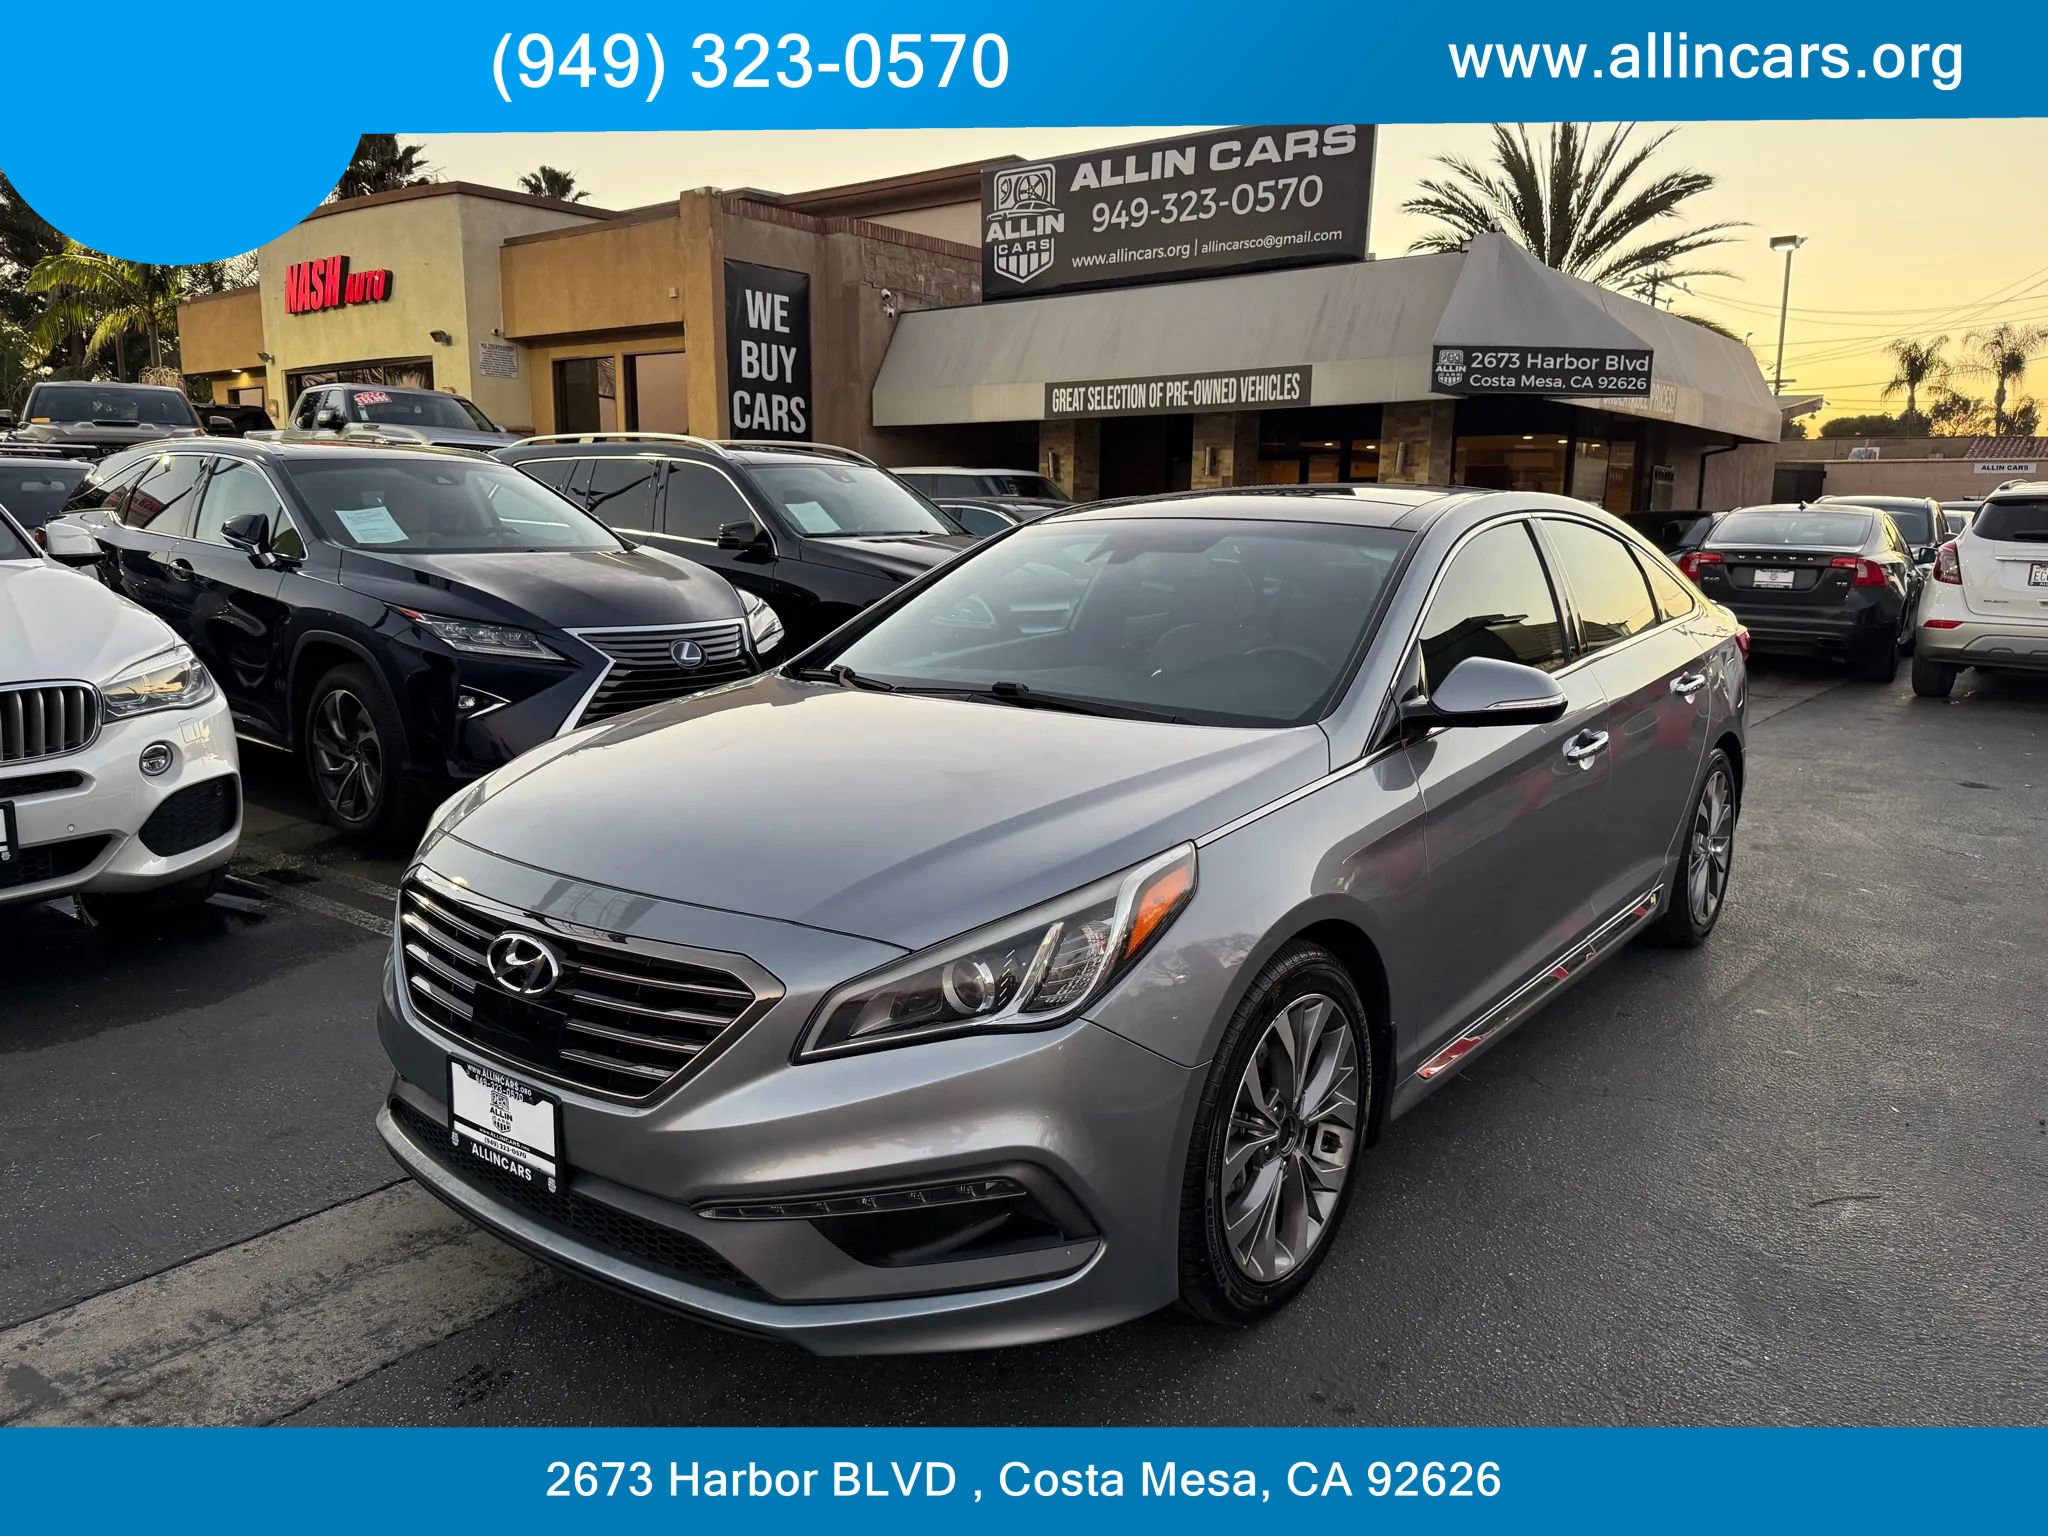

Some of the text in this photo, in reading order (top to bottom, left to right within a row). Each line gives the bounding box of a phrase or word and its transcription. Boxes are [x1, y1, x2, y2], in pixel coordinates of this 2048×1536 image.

[1069, 124, 1357, 191] ALLIN CARS
[1092, 174, 1323, 233] 949-323-0570
[986, 213, 1064, 243] ALLIN
[998, 239, 1050, 254] CARS
[1072, 229, 1342, 268] www.allincars.org allincarsco@gmail.com
[285, 254, 386, 314] NASH AUTO
[745, 289, 790, 333] WE
[741, 340, 797, 383] BUY
[1471, 352, 1650, 372] 2673 Harbor Blvd
[1052, 372, 1300, 413] GREAT SELECTION OF PRE-OWNED VEHICLES
[1470, 374, 1647, 390] Costa Mesa, CA 92626
[733, 390, 806, 434] CARS
[490, 1106, 513, 1122] ALLIN
[471, 1143, 532, 1181] ALLINCARS
